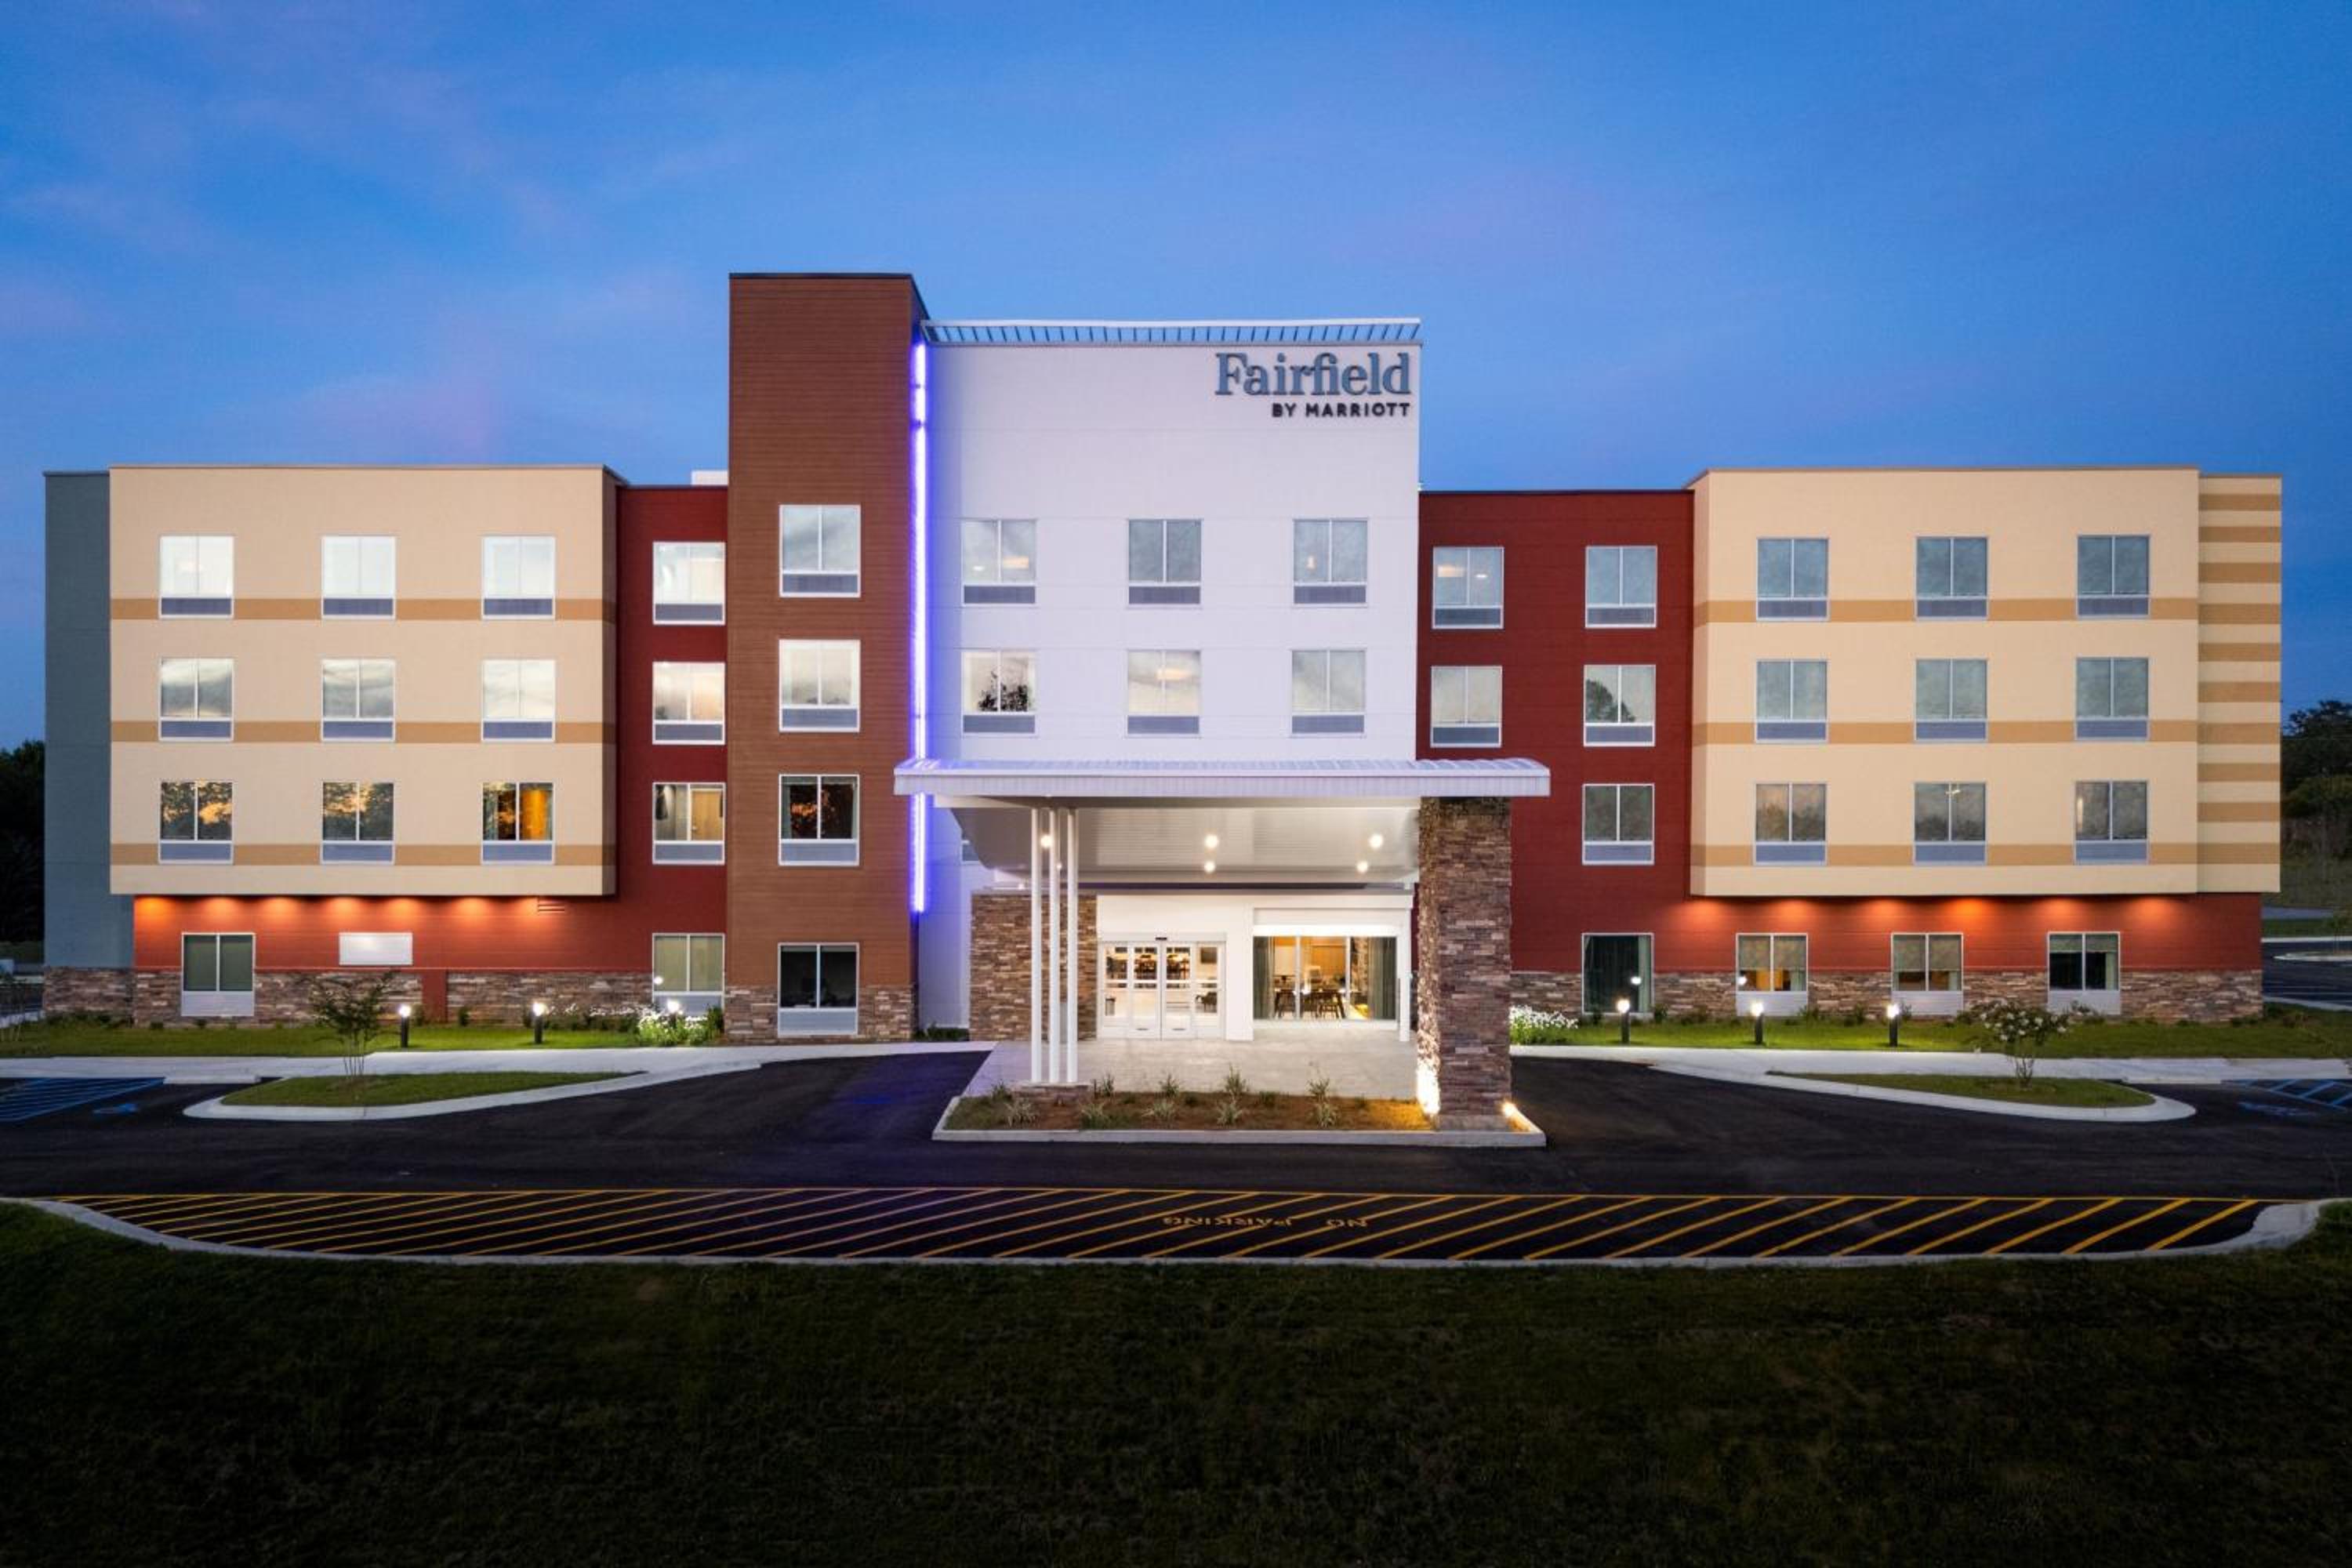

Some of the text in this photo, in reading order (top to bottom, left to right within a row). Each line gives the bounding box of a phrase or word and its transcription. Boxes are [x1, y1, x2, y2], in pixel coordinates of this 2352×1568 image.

[1214, 353, 1411, 396] Fairfield
[1272, 402, 1410, 417] BY MARRIOTT
[1163, 1217, 1367, 1227] NO PARKING
